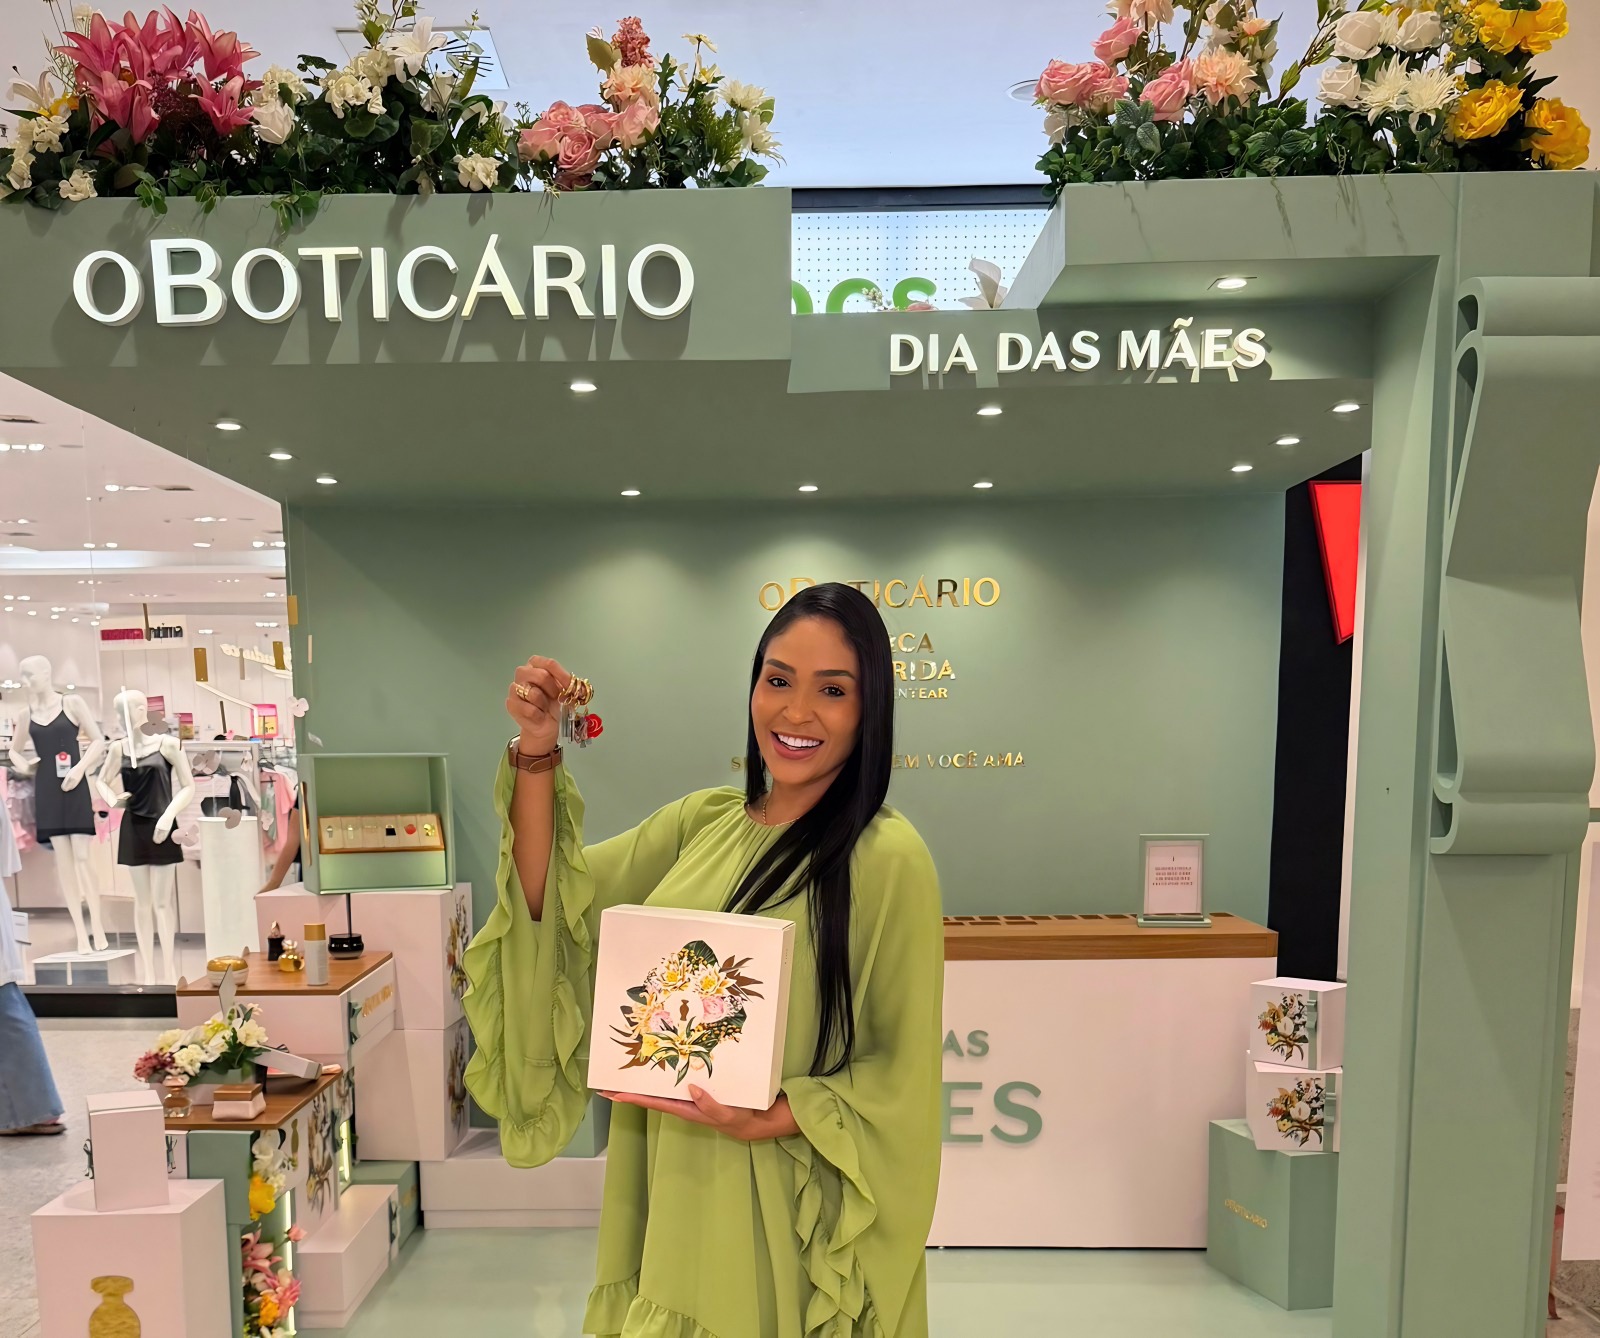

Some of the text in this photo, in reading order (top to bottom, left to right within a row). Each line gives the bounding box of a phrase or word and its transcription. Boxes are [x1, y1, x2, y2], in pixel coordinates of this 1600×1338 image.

[889, 316, 1268, 375] DIA DAS MÃES
